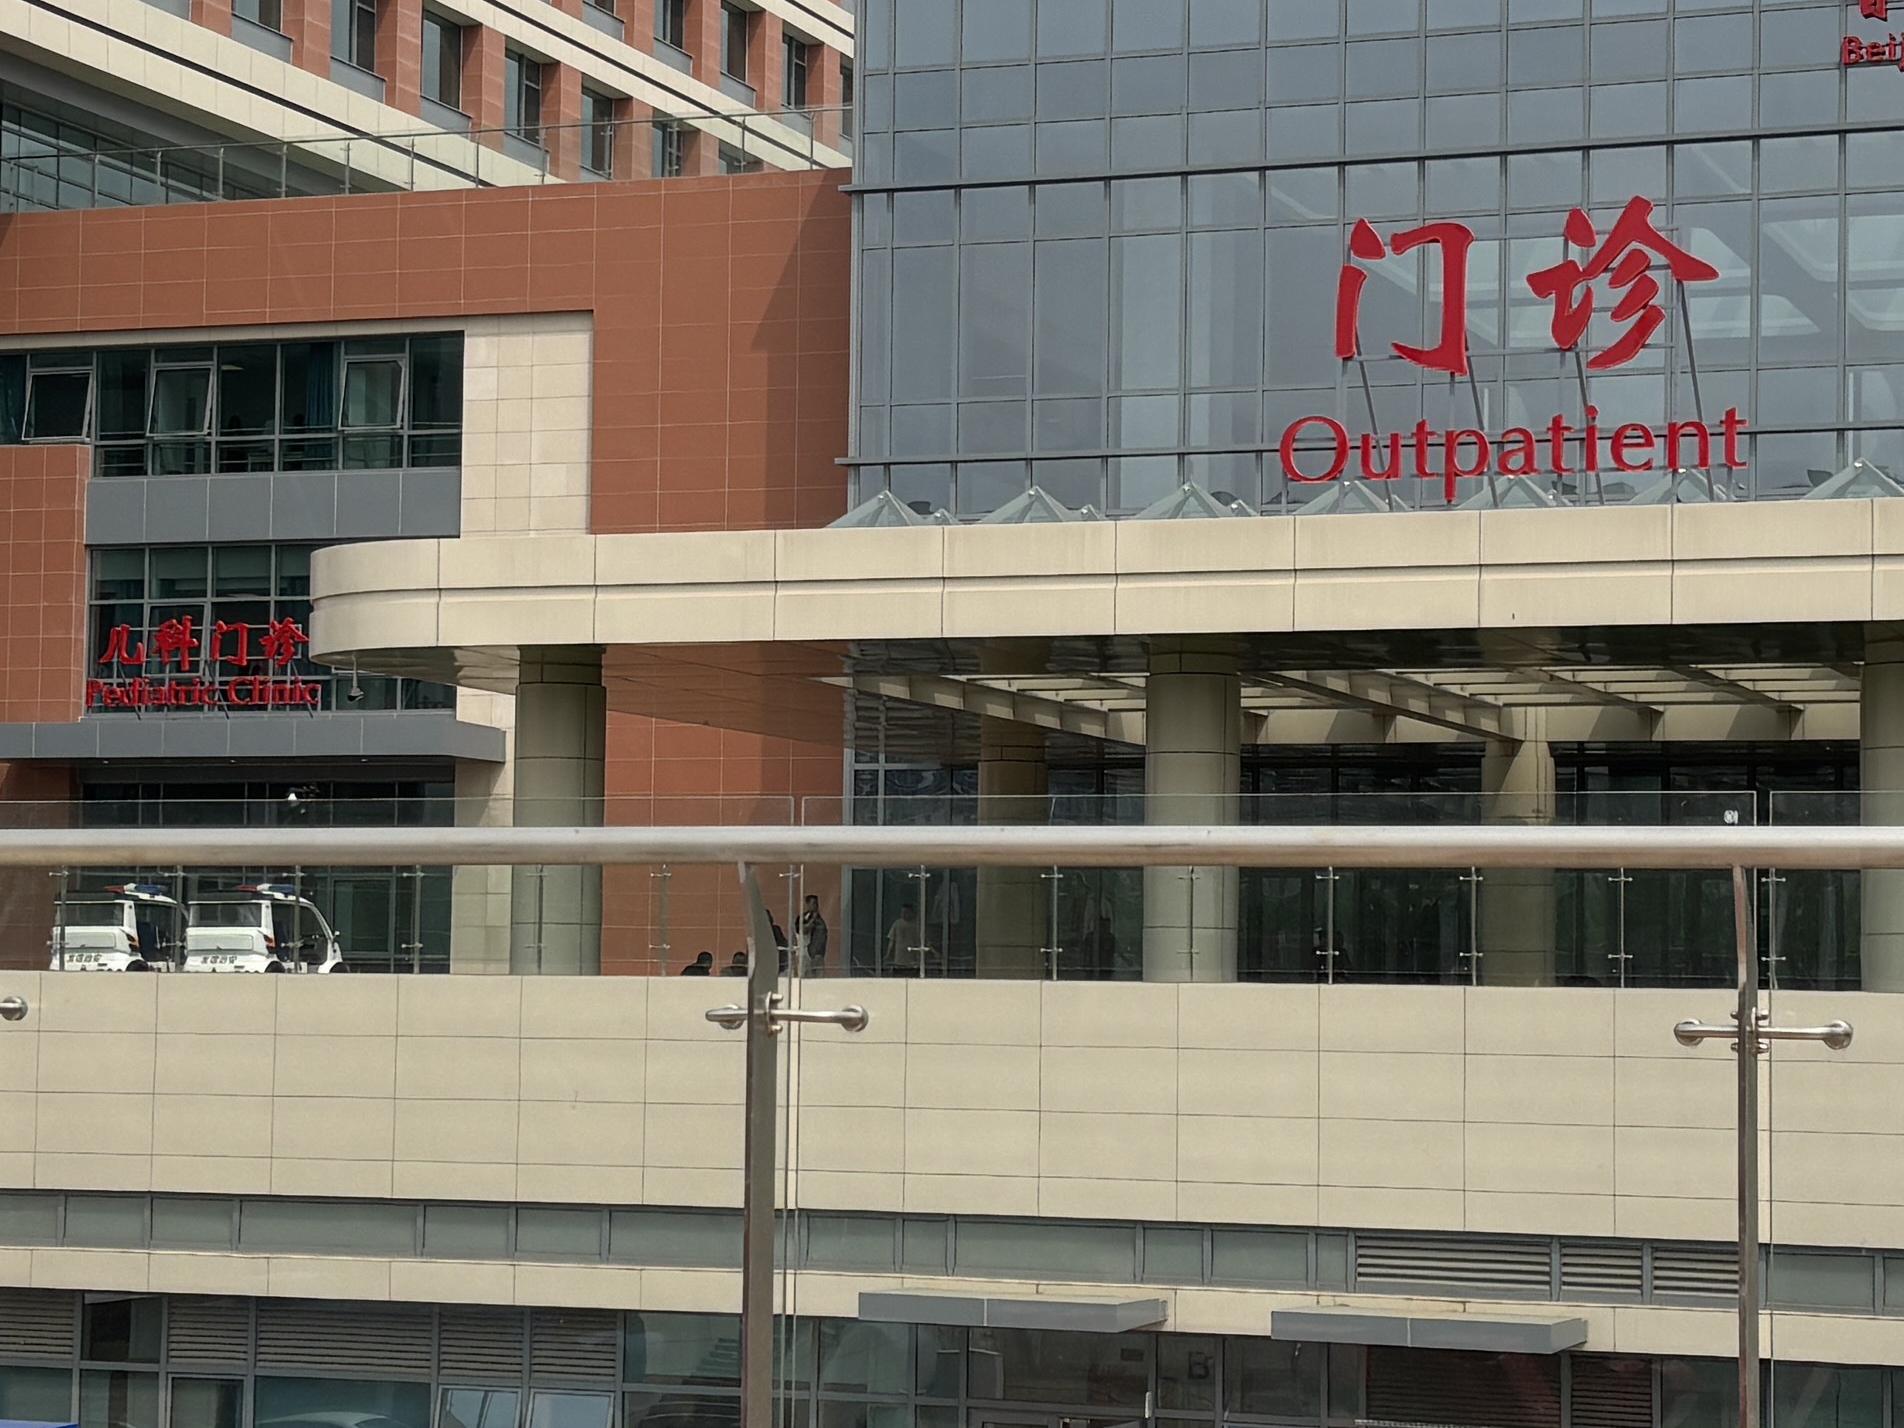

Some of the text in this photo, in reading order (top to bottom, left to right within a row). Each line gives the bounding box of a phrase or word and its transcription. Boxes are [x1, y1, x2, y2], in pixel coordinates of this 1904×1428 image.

[1333, 194, 1721, 377] 门诊
[1278, 404, 1749, 505] Outpatient
[97, 614, 310, 672] 儿科门诊
[86, 674, 322, 708] Pediatric Clinic
